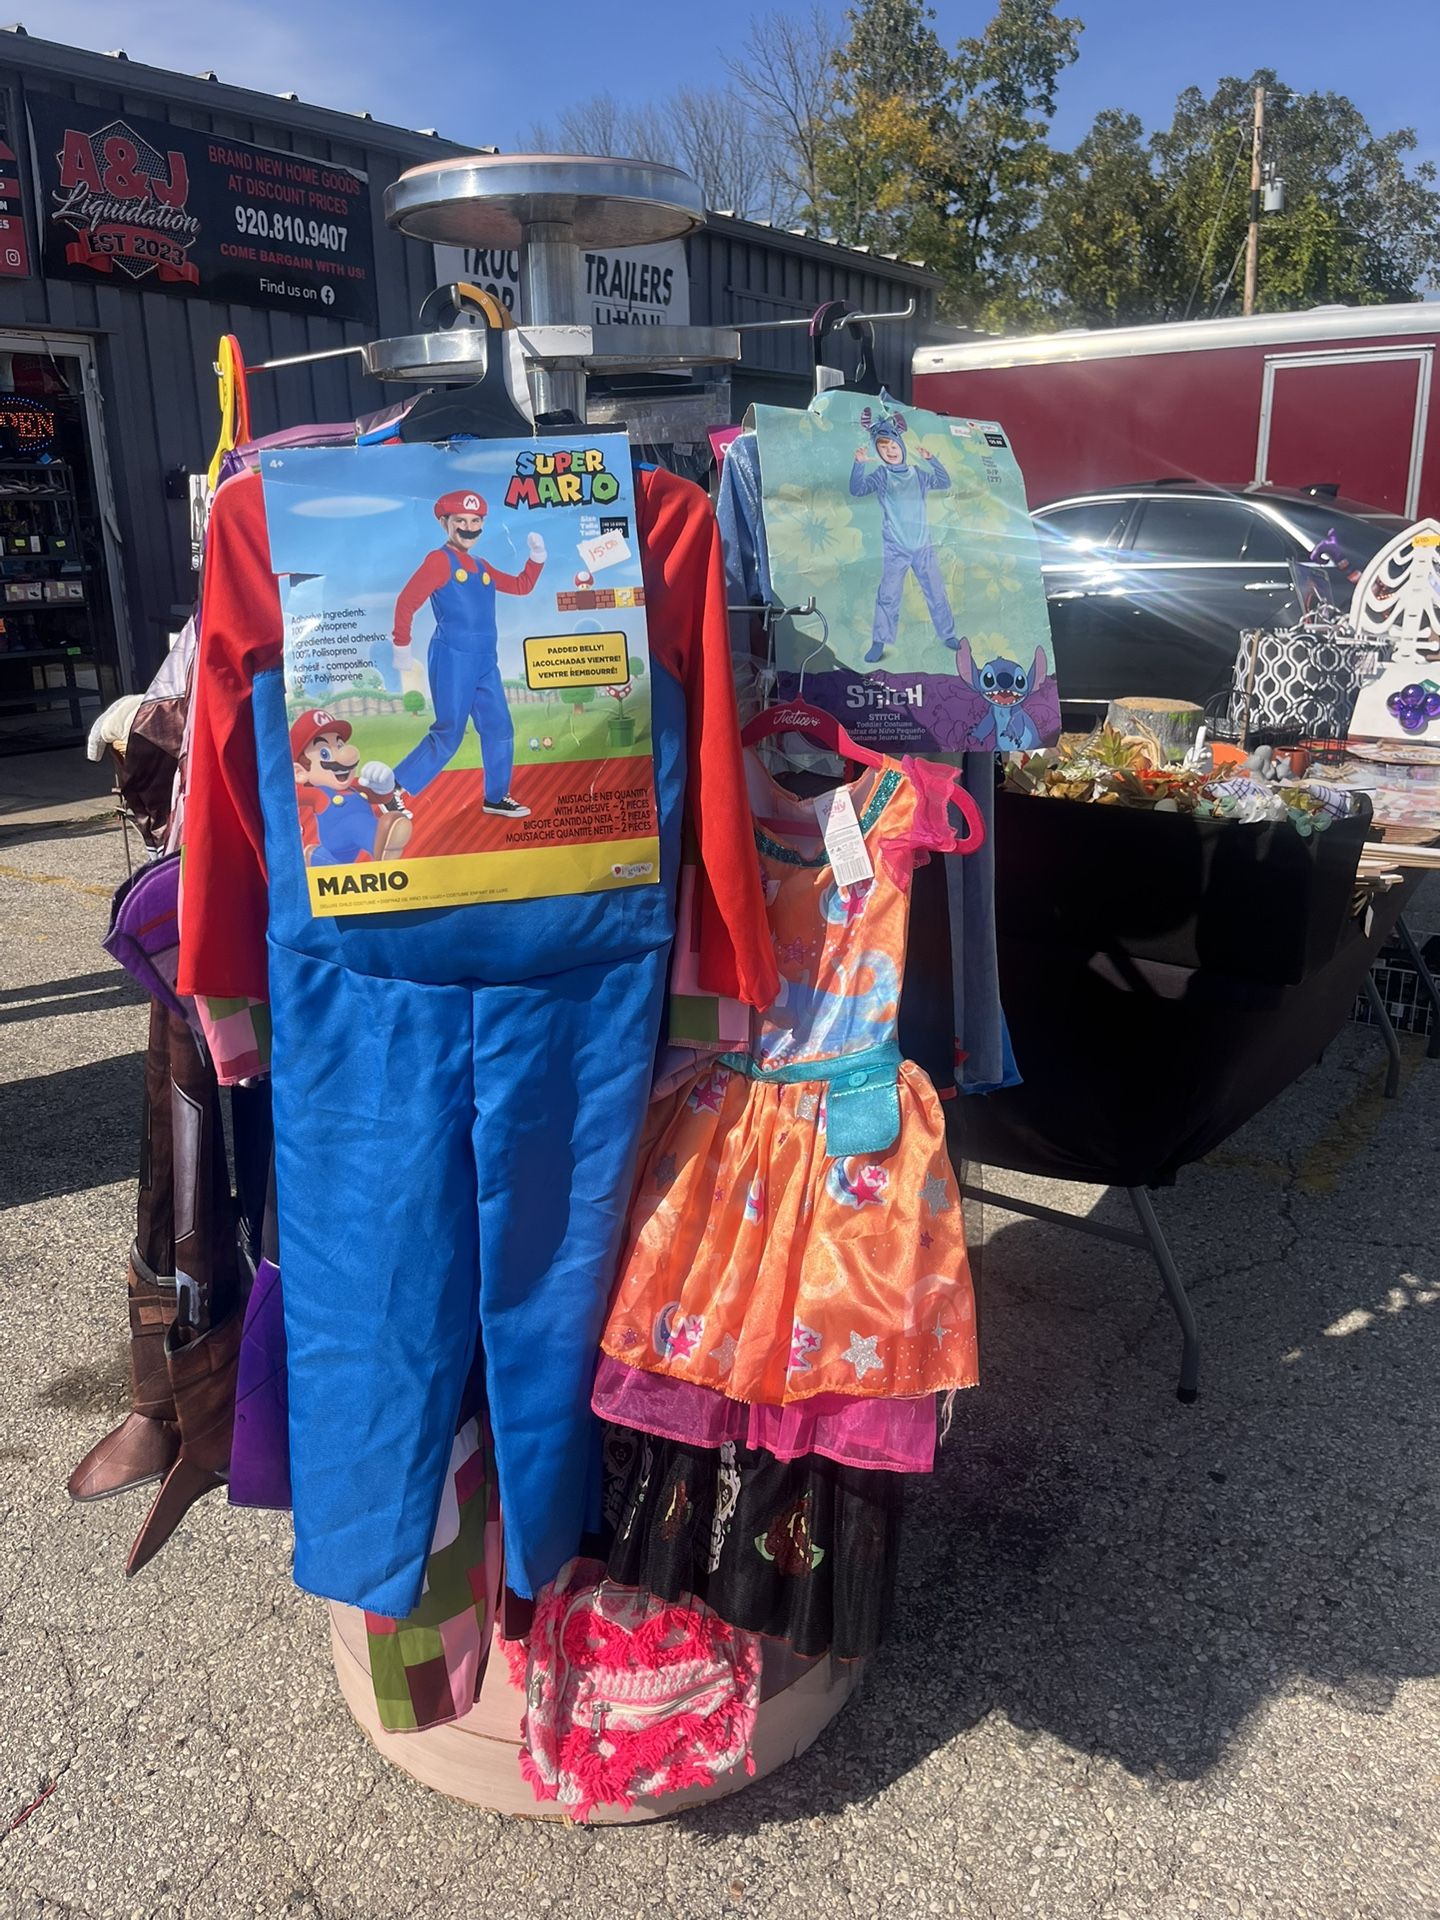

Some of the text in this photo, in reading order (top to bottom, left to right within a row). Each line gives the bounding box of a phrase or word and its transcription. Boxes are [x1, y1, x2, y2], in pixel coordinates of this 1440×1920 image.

[60, 129, 189, 208] A&J
[209, 145, 360, 195] BRAND NEW HOME GOODS
[228, 174, 348, 215] AT DISCOUNT PRICES
[52, 181, 200, 232] Liquidation
[235, 205, 348, 252] 920.810.9407
[88, 231, 185, 266] EST 2023
[220, 243, 365, 280] COME BARGAIN WITH US!
[259, 278, 317, 300] Find us on
[585, 253, 674, 307] TRAILERS
[0, 412, 54, 437] PEN
[516, 448, 607, 477] SUPER
[504, 472, 620, 510] MARIO
[322, 607, 366, 620] ingredients:
[337, 634, 350, 643] del
[351, 633, 387, 643] adhesivo:
[547, 643, 604, 654] PADDED BELLY!
[587, 655, 621, 664] VIENTRE!
[538, 670, 569, 679] VENTRE
[856, 721, 882, 729] Toddler
[868, 713, 901, 721] STITCH
[896, 727, 926, 735] Pequeño
[554, 805, 573, 816] WITH
[574, 803, 611, 814] ADHESIVE
[620, 800, 626, 810] 2
[626, 799, 650, 810] PIECES
[557, 788, 649, 805] MUSTACHE NET QUANTITY
[523, 820, 552, 830] BIGOTE
[553, 815, 593, 827] CANTIDAD
[594, 814, 614, 824] NETA
[621, 811, 626, 821] 2
[505, 829, 555, 843] MOUSTACHE
[593, 824, 614, 836] NETTE
[621, 822, 627, 833] 2
[316, 870, 409, 897] MARIO
